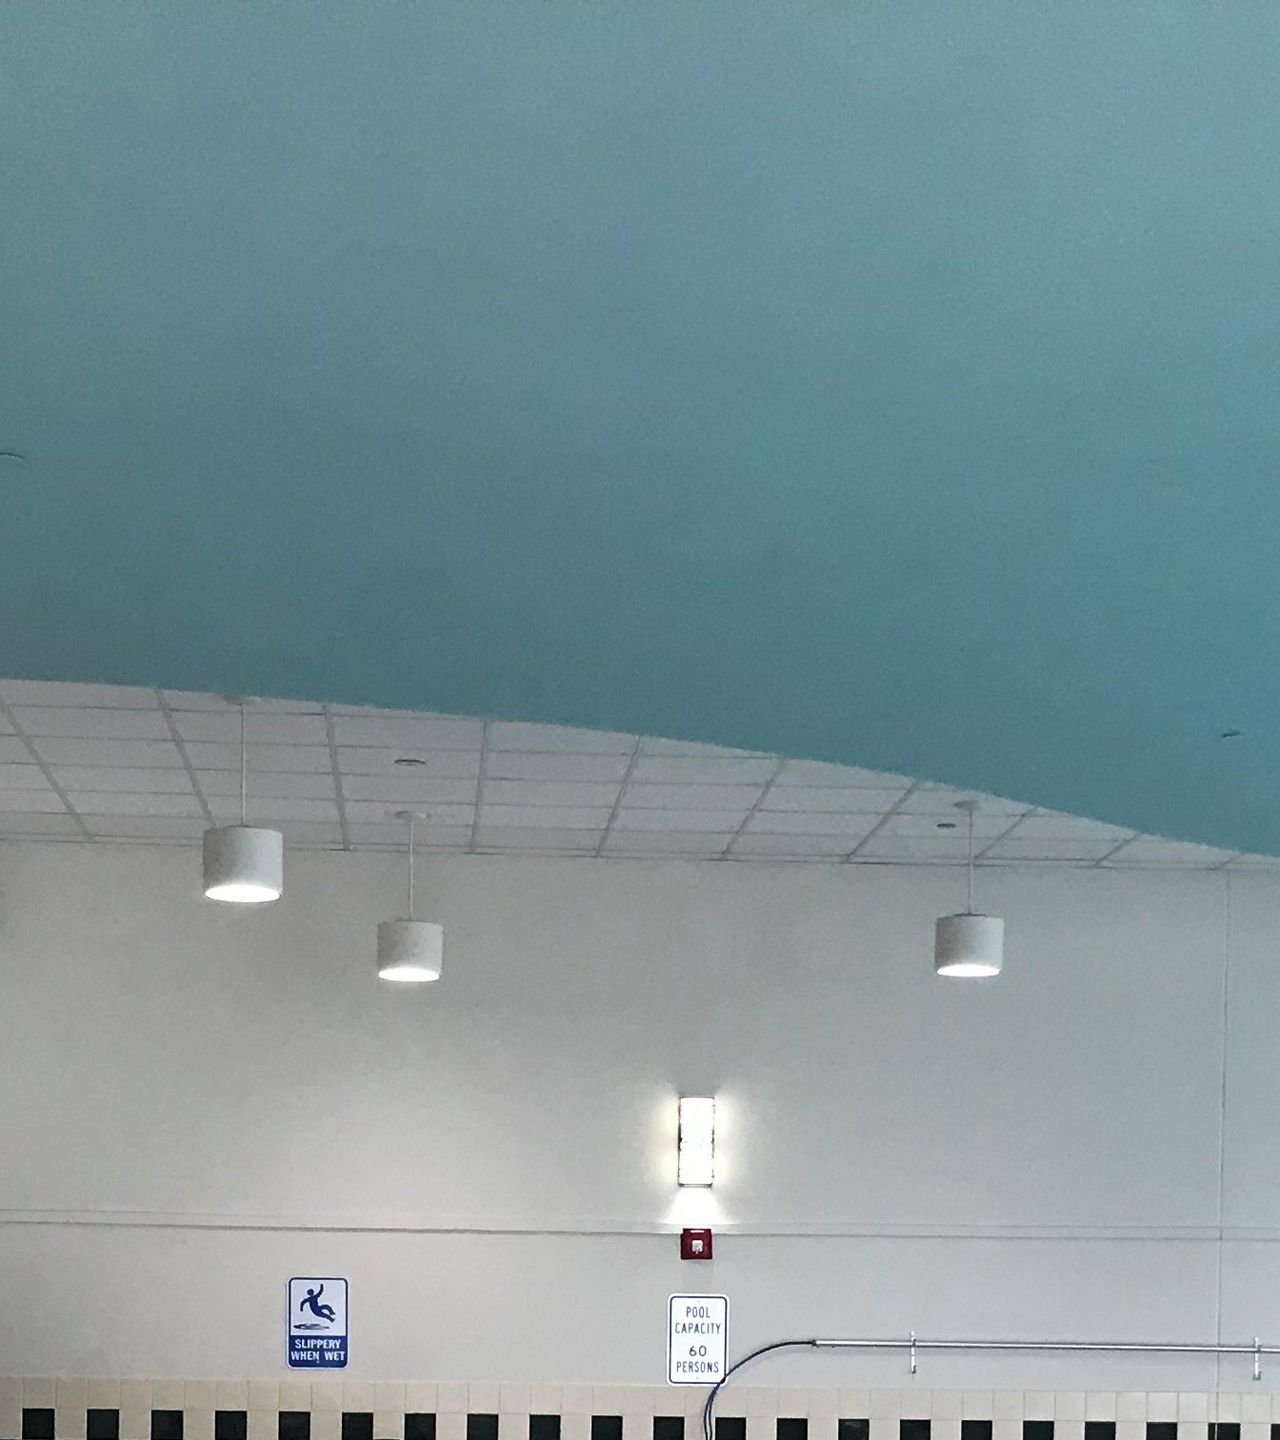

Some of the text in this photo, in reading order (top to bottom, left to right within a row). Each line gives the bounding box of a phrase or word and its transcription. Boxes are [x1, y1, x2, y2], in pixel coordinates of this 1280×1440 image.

[686, 1306, 711, 1318] POOL
[675, 1322, 721, 1334] CAPACITY
[294, 1338, 341, 1349] SLIPPERY
[290, 1351, 345, 1361] WHEN WET
[689, 1345, 707, 1357] 60
[676, 1361, 719, 1373] PERSONS
